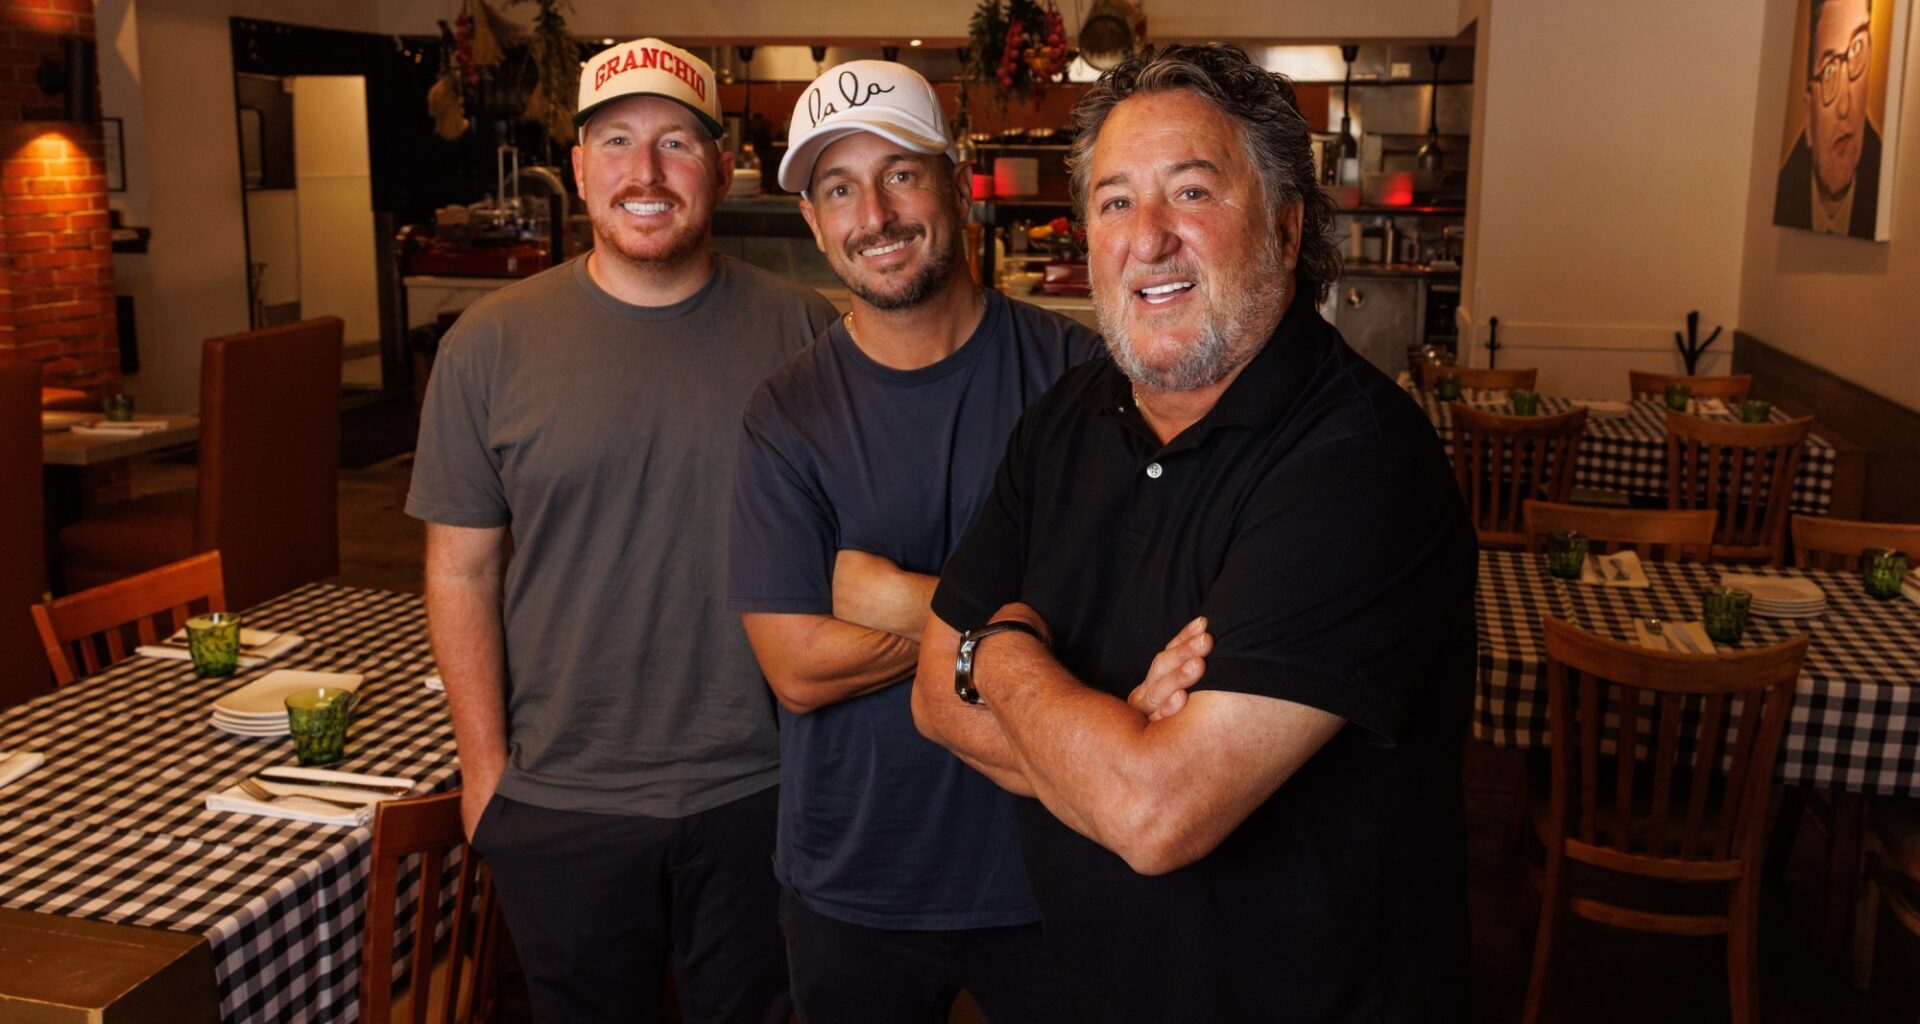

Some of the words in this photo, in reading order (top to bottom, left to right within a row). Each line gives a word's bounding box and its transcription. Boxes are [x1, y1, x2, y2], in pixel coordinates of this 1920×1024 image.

[595, 47, 705, 102] GRANCHIO
[808, 87, 839, 128] la
[838, 71, 895, 108] la
